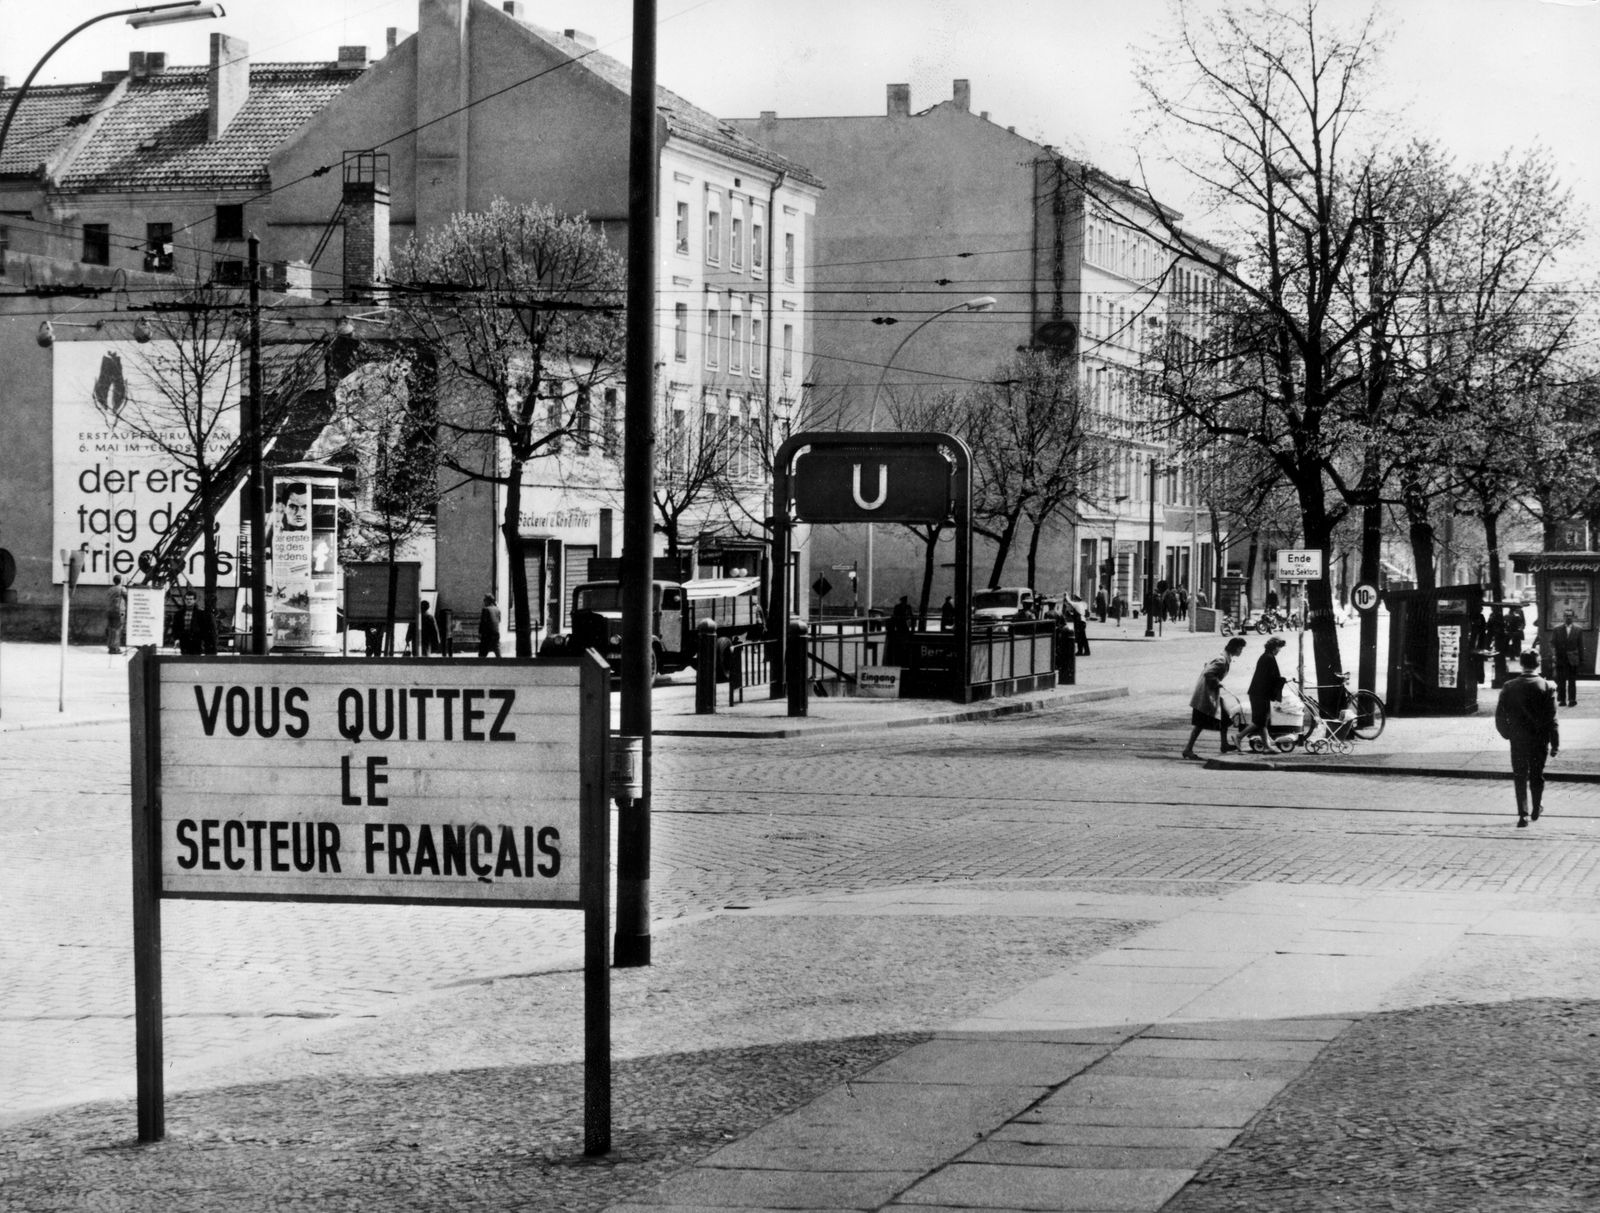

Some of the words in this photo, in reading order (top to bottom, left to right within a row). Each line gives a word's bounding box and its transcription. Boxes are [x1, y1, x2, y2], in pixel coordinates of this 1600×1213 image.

[79, 444, 89, 452] 6.
[212, 432, 231, 440] AM
[79, 463, 140, 494] der
[146, 469, 203, 494] ers
[853, 464, 887, 510] U
[77, 504, 136, 543] tag
[79, 543, 233, 575] friens
[286, 543, 304, 551] des
[1287, 553, 1311, 563] Ende
[1356, 589, 1369, 605] 10
[861, 672, 896, 684] Eingang
[194, 685, 309, 738] VOUS
[338, 688, 516, 744] QUITTEZ
[341, 756, 389, 807] LE
[177, 819, 342, 874] SECTEUR
[365, 823, 561, 883] FRANÇAIS
